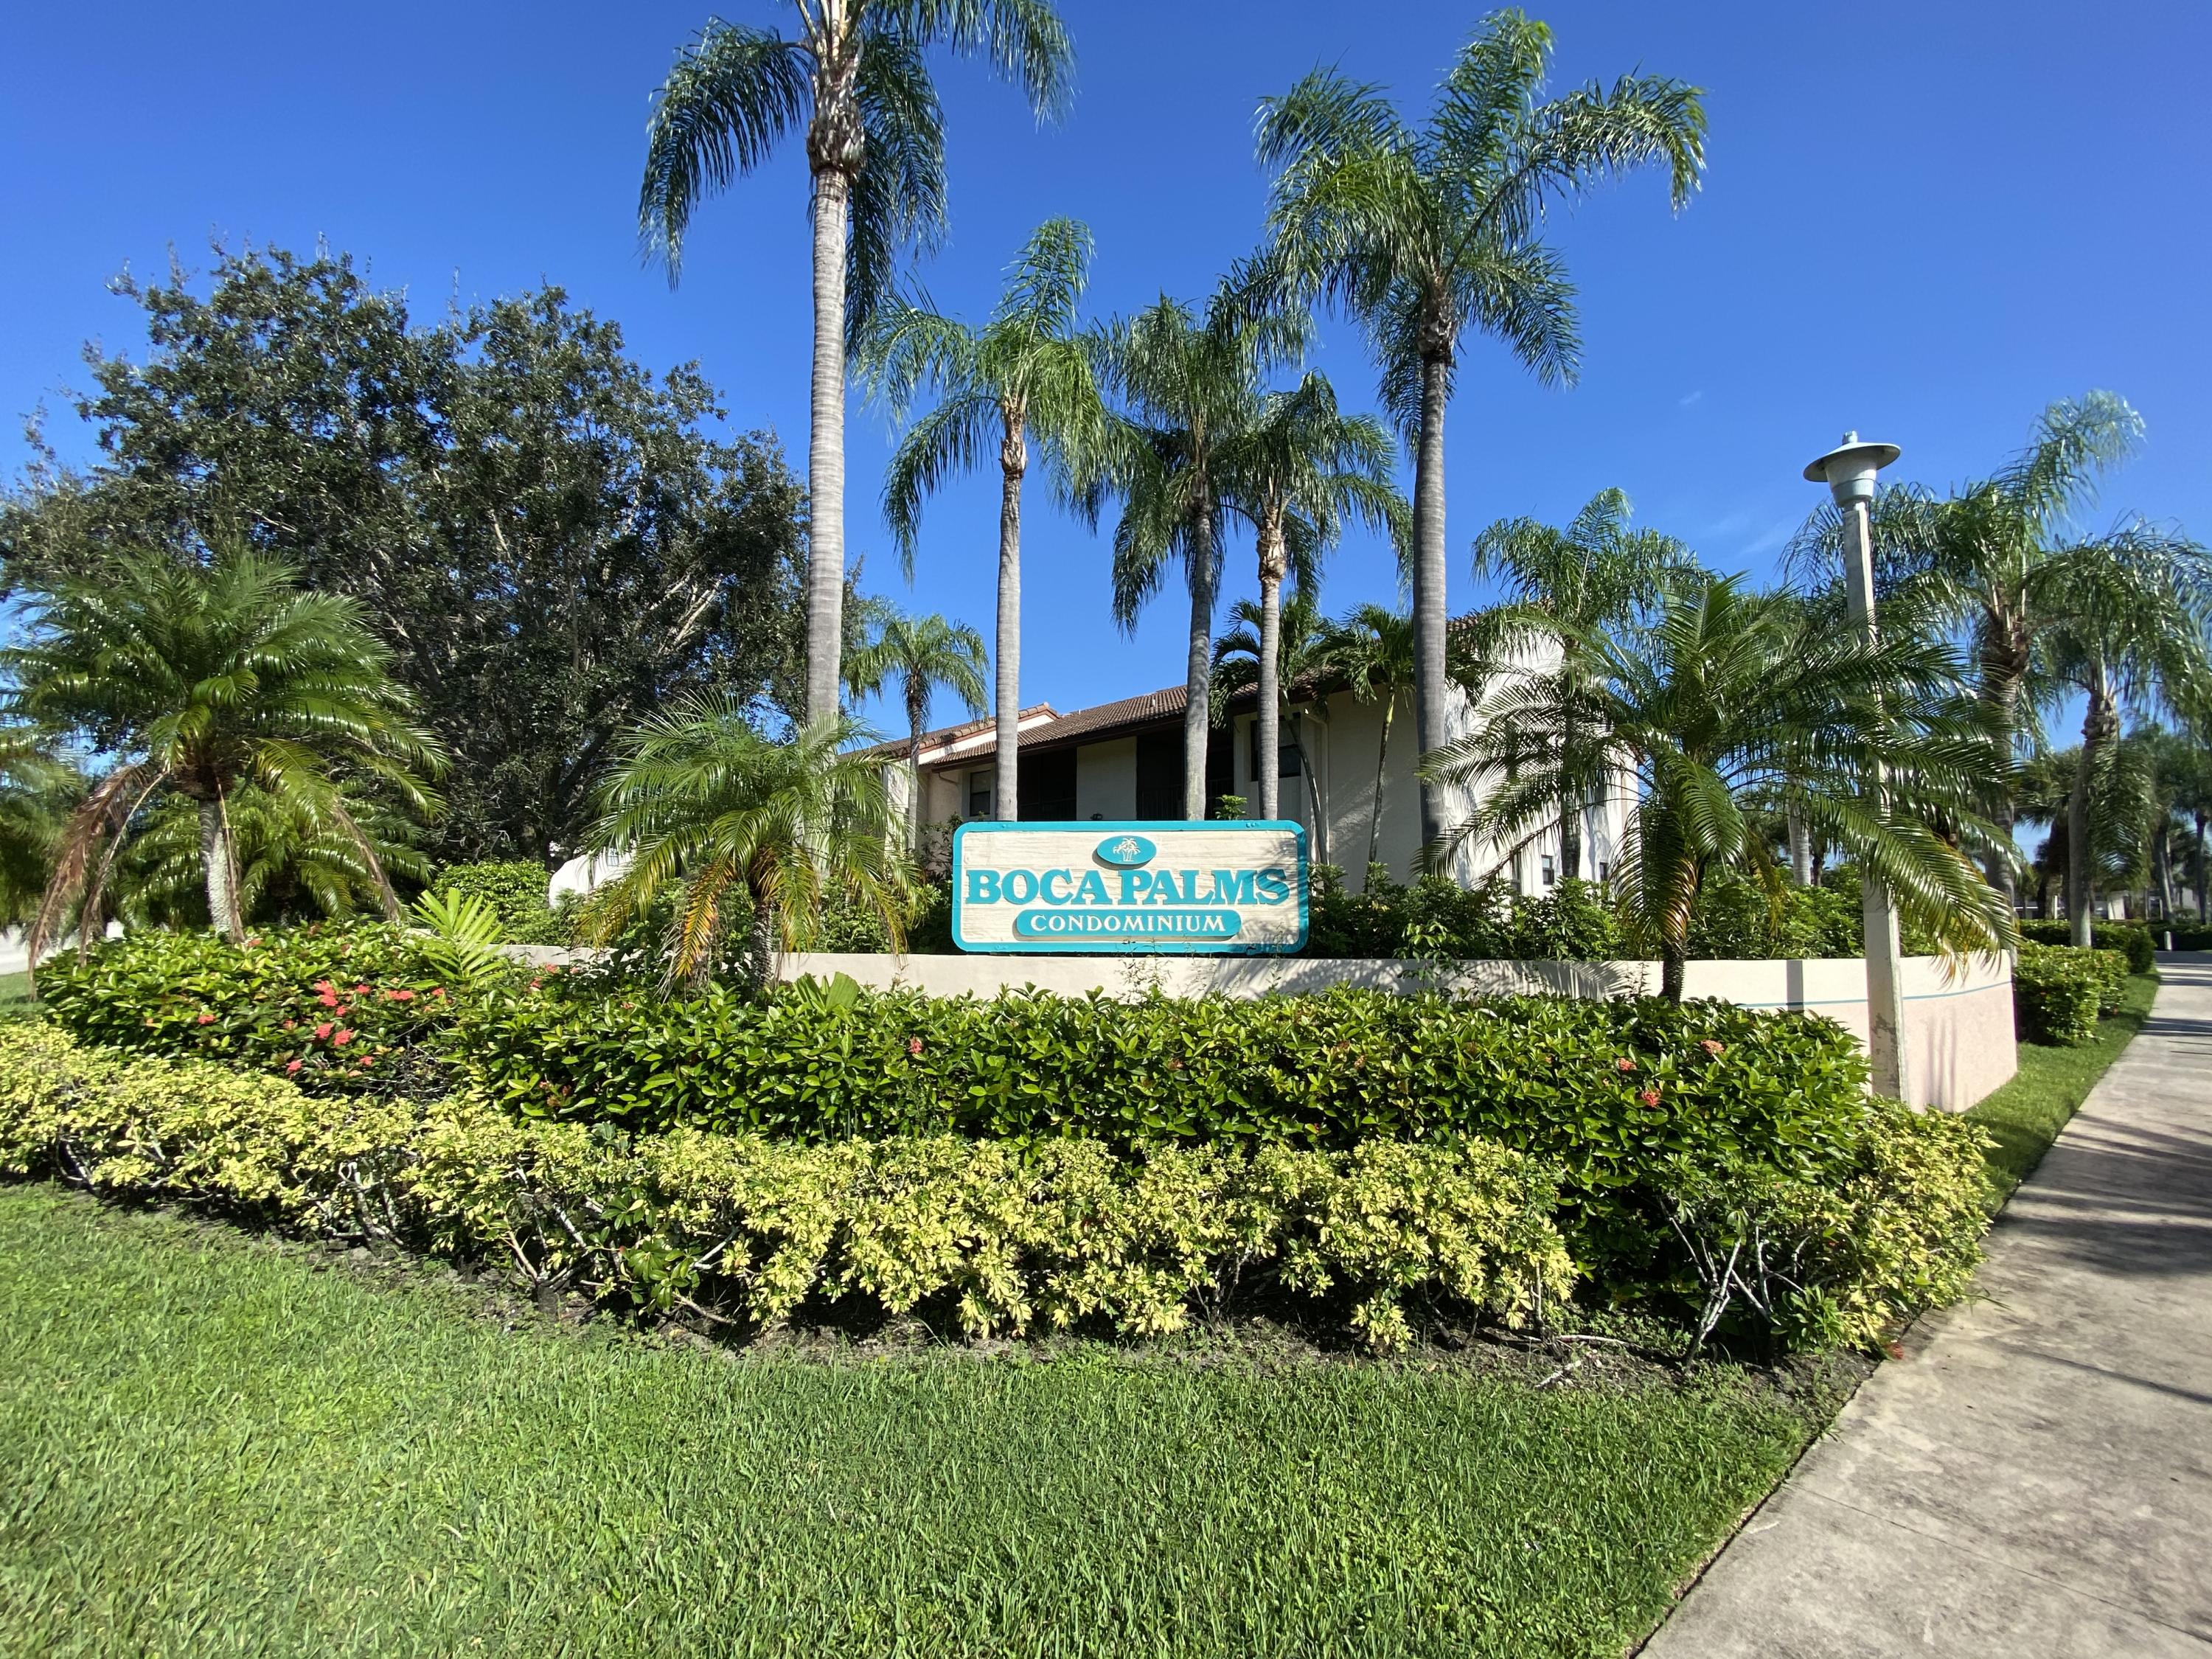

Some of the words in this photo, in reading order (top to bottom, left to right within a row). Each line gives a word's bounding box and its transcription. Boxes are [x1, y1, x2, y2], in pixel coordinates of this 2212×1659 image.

[965, 869, 1113, 905] BOCA
[1118, 869, 1290, 906] PALMS
[1030, 914, 1226, 933] CONDOMINIUM
